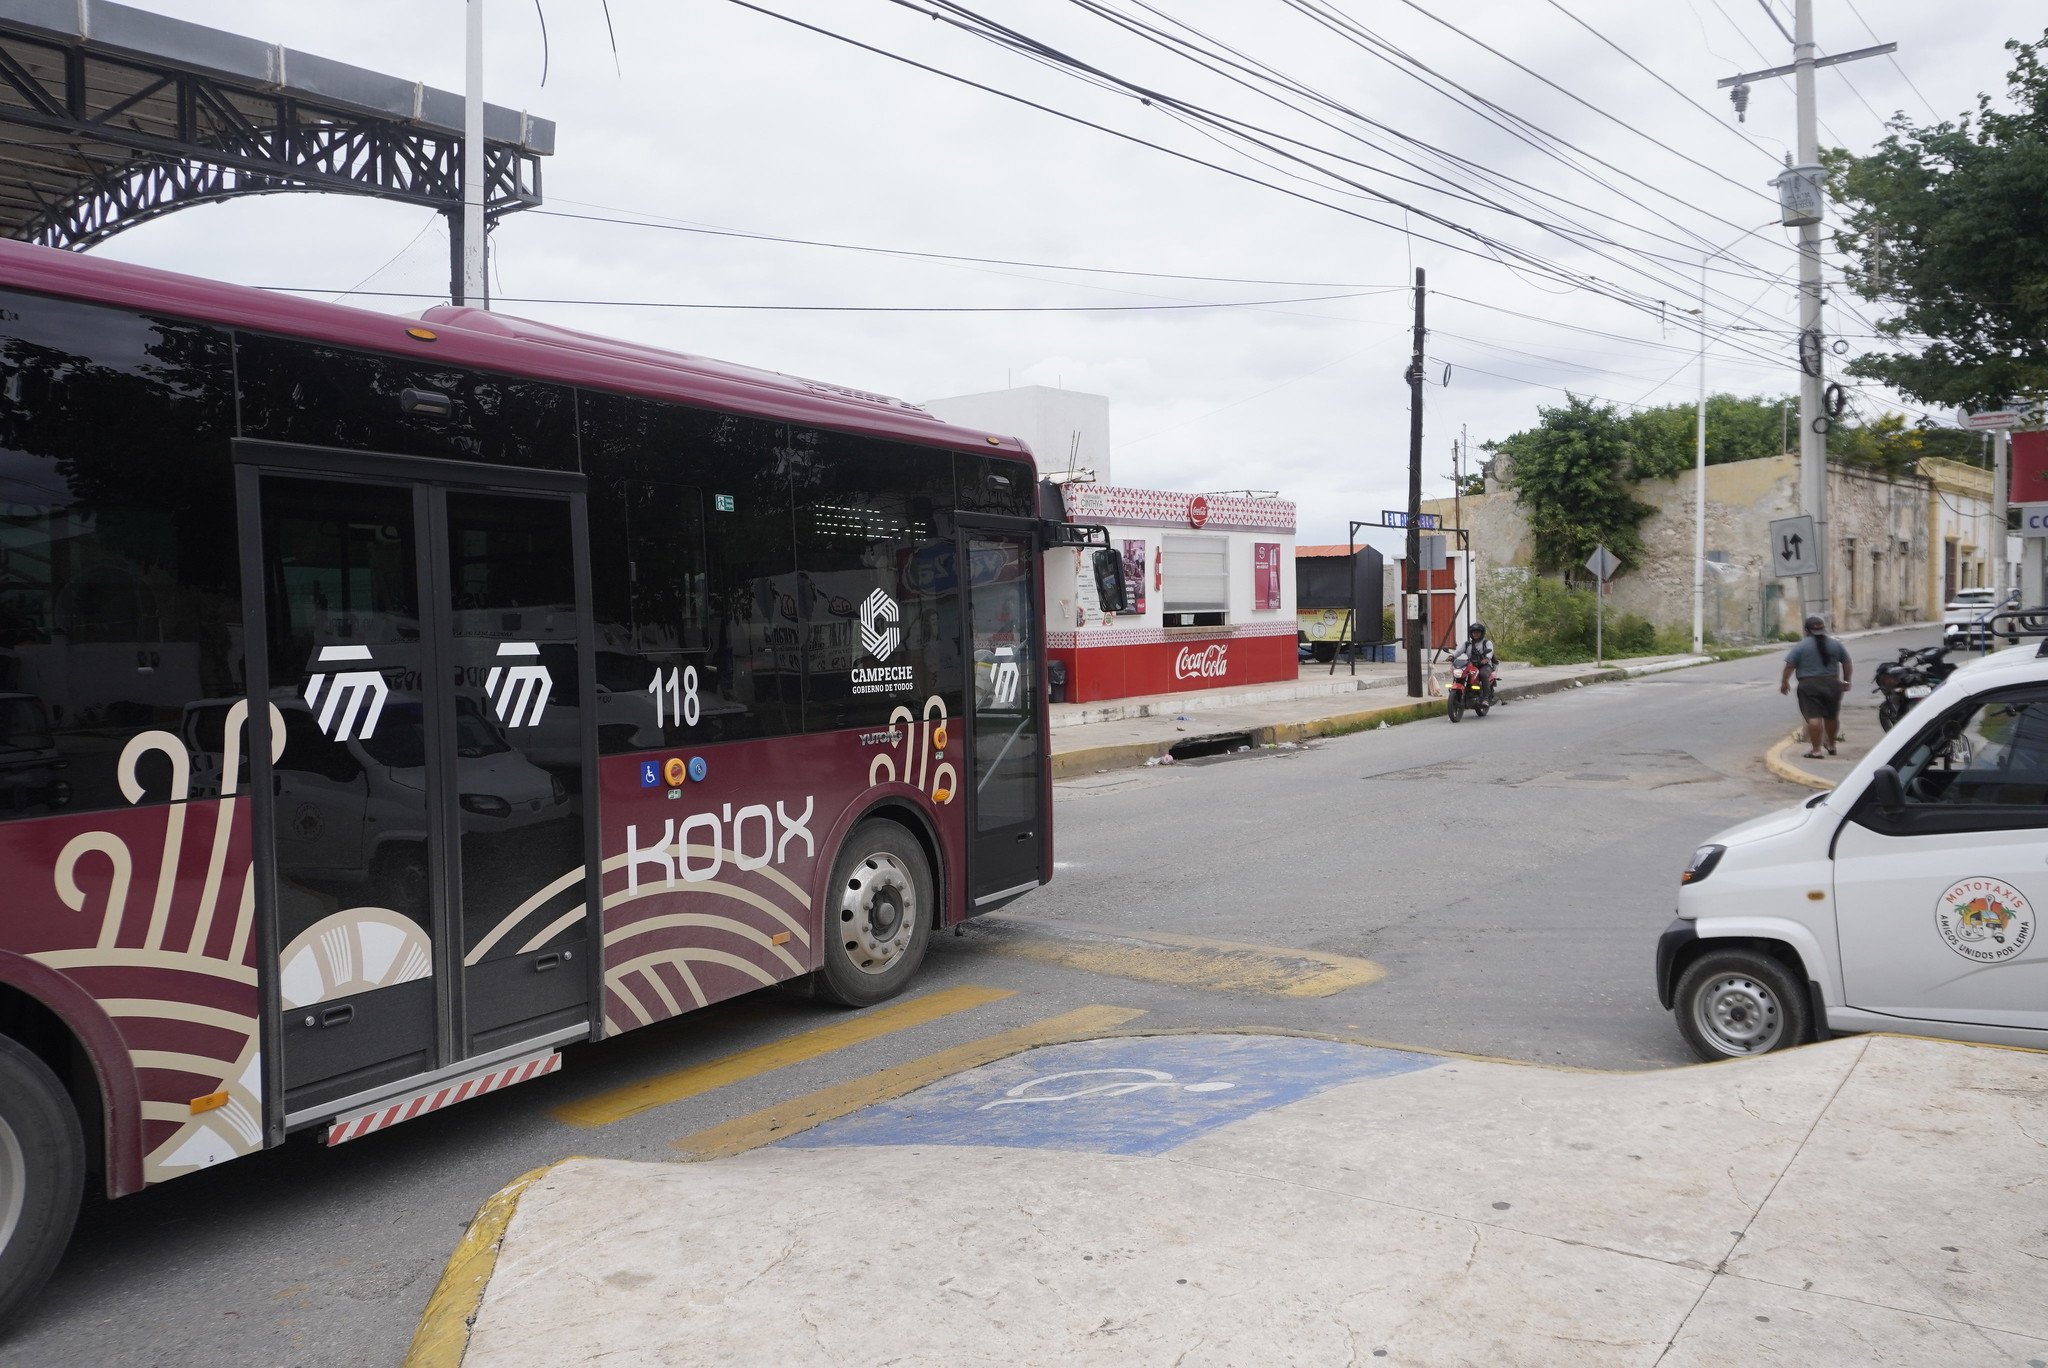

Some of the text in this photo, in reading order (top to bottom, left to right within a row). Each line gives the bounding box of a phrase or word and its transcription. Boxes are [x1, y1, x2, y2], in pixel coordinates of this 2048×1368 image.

[851, 666, 913, 684] CAMPECHE
[1175, 644, 1228, 680] Coca-Cola
[648, 665, 700, 729] 118
[852, 682, 914, 695] GOBIERNO DE TODOS
[859, 730, 903, 746] YUTONG
[1946, 882, 2023, 908] MOTOTAXIS
[1940, 914, 2030, 960] AMIGOS UNIDOS POR LERMA
